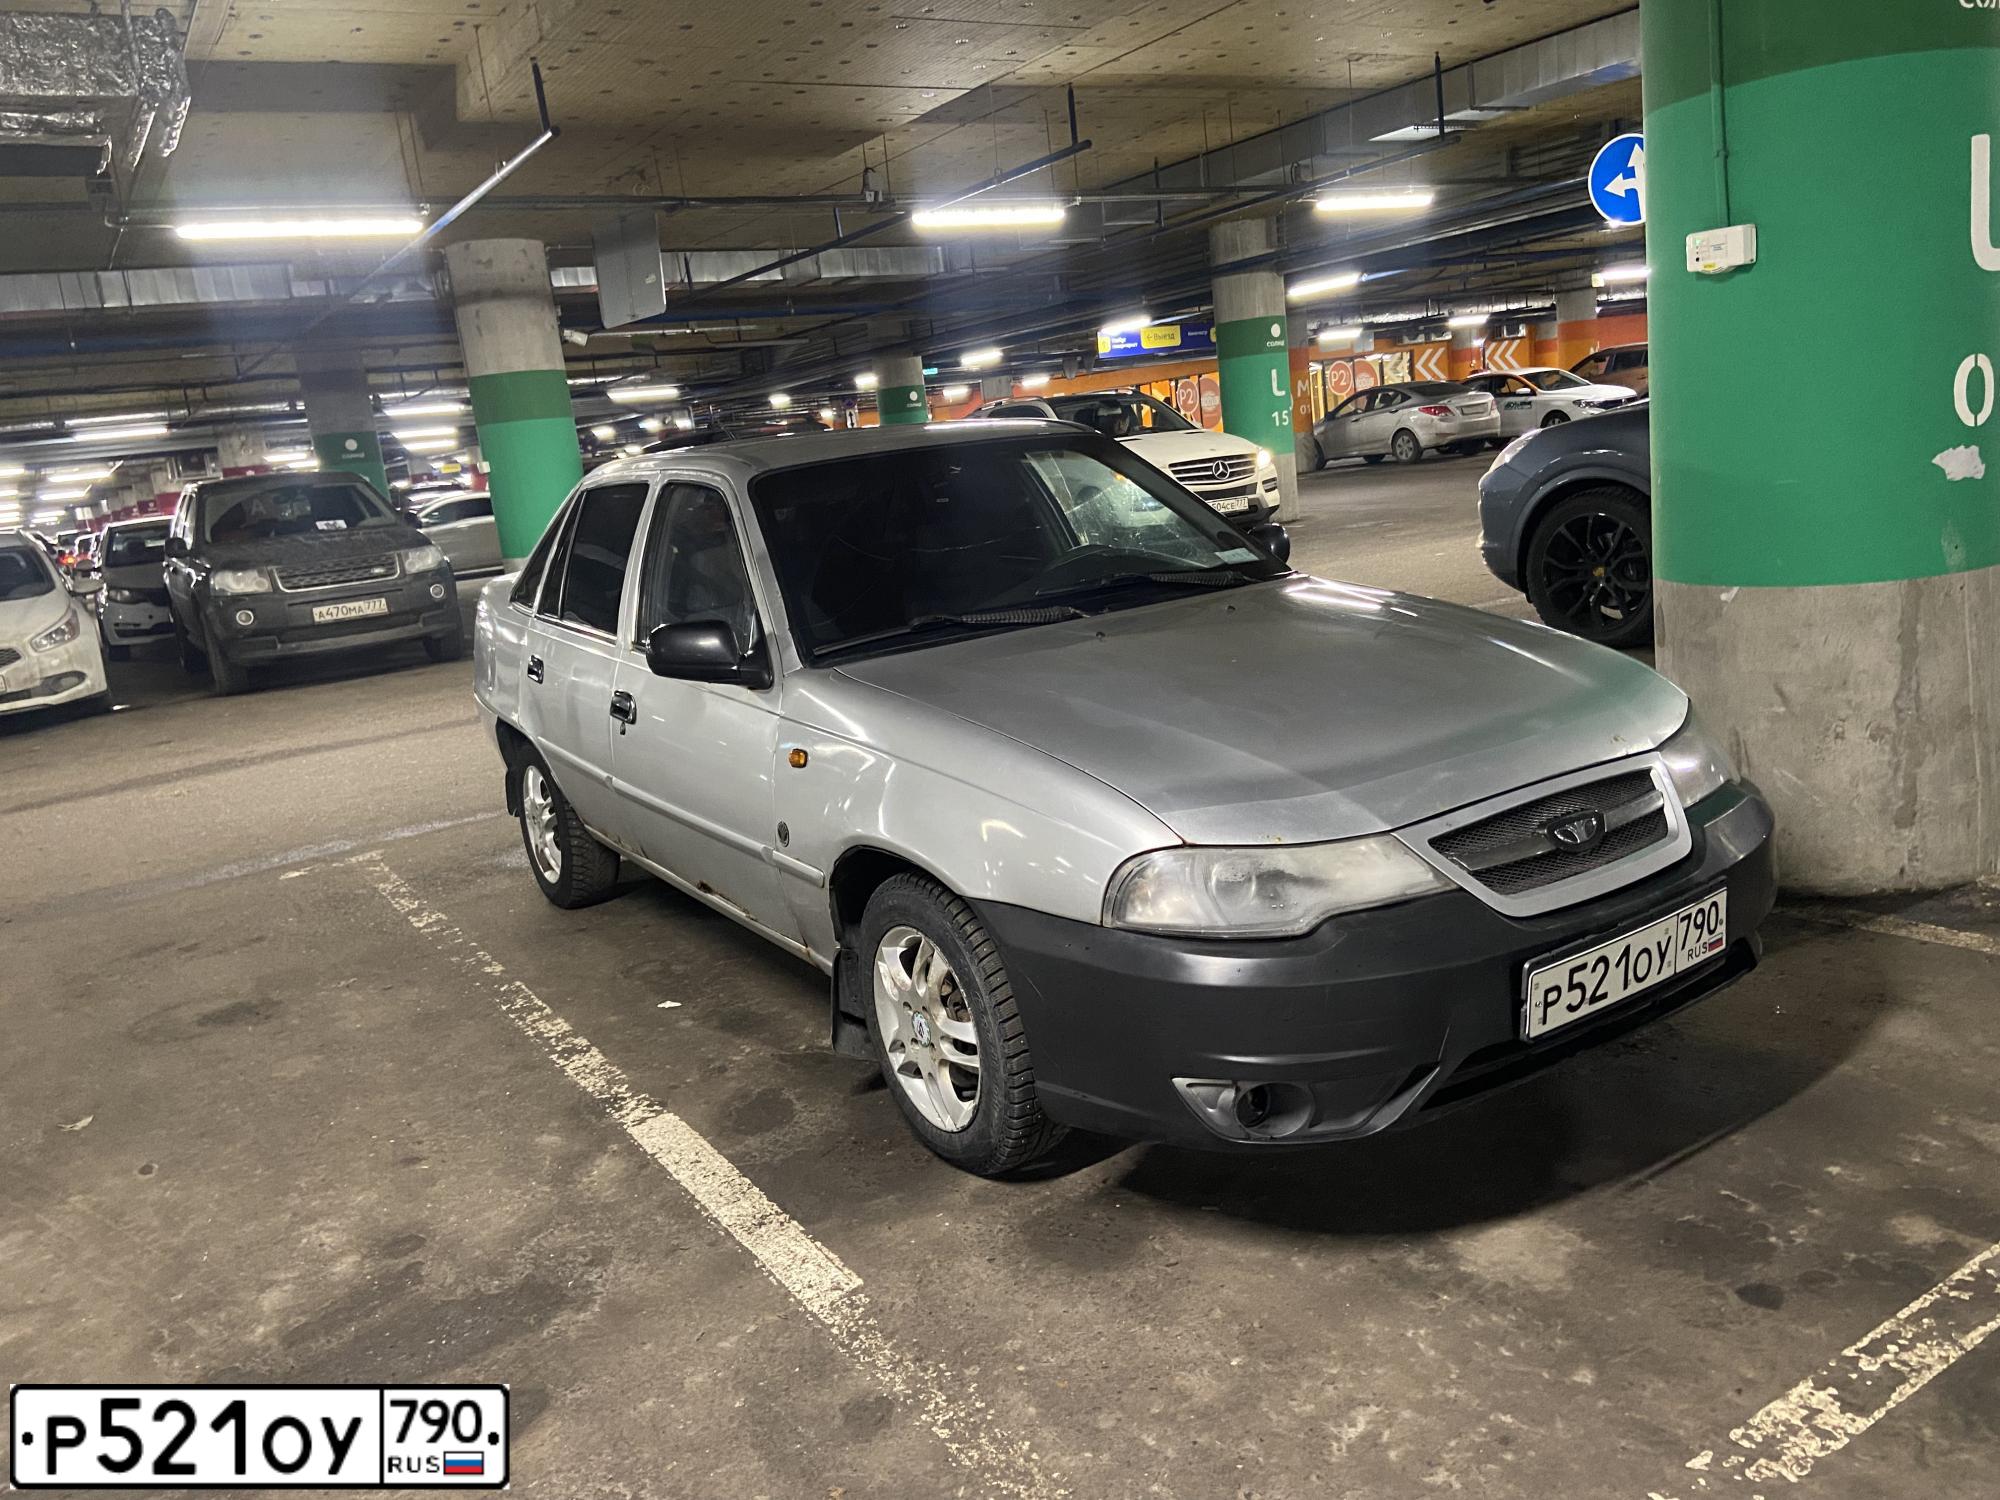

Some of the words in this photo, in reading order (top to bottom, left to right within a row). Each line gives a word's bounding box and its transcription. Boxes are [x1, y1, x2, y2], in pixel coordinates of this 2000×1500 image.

[1271, 369, 1286, 396] L
[1331, 370, 1347, 387] P2
[1297, 380, 1310, 397] M
[1179, 389, 1195, 406] P2
[1272, 410, 1290, 426] 15
[1687, 941, 1708, 962] RUS
[1542, 936, 1672, 1026] Р521ОУ
[1680, 901, 1720, 951] 790
